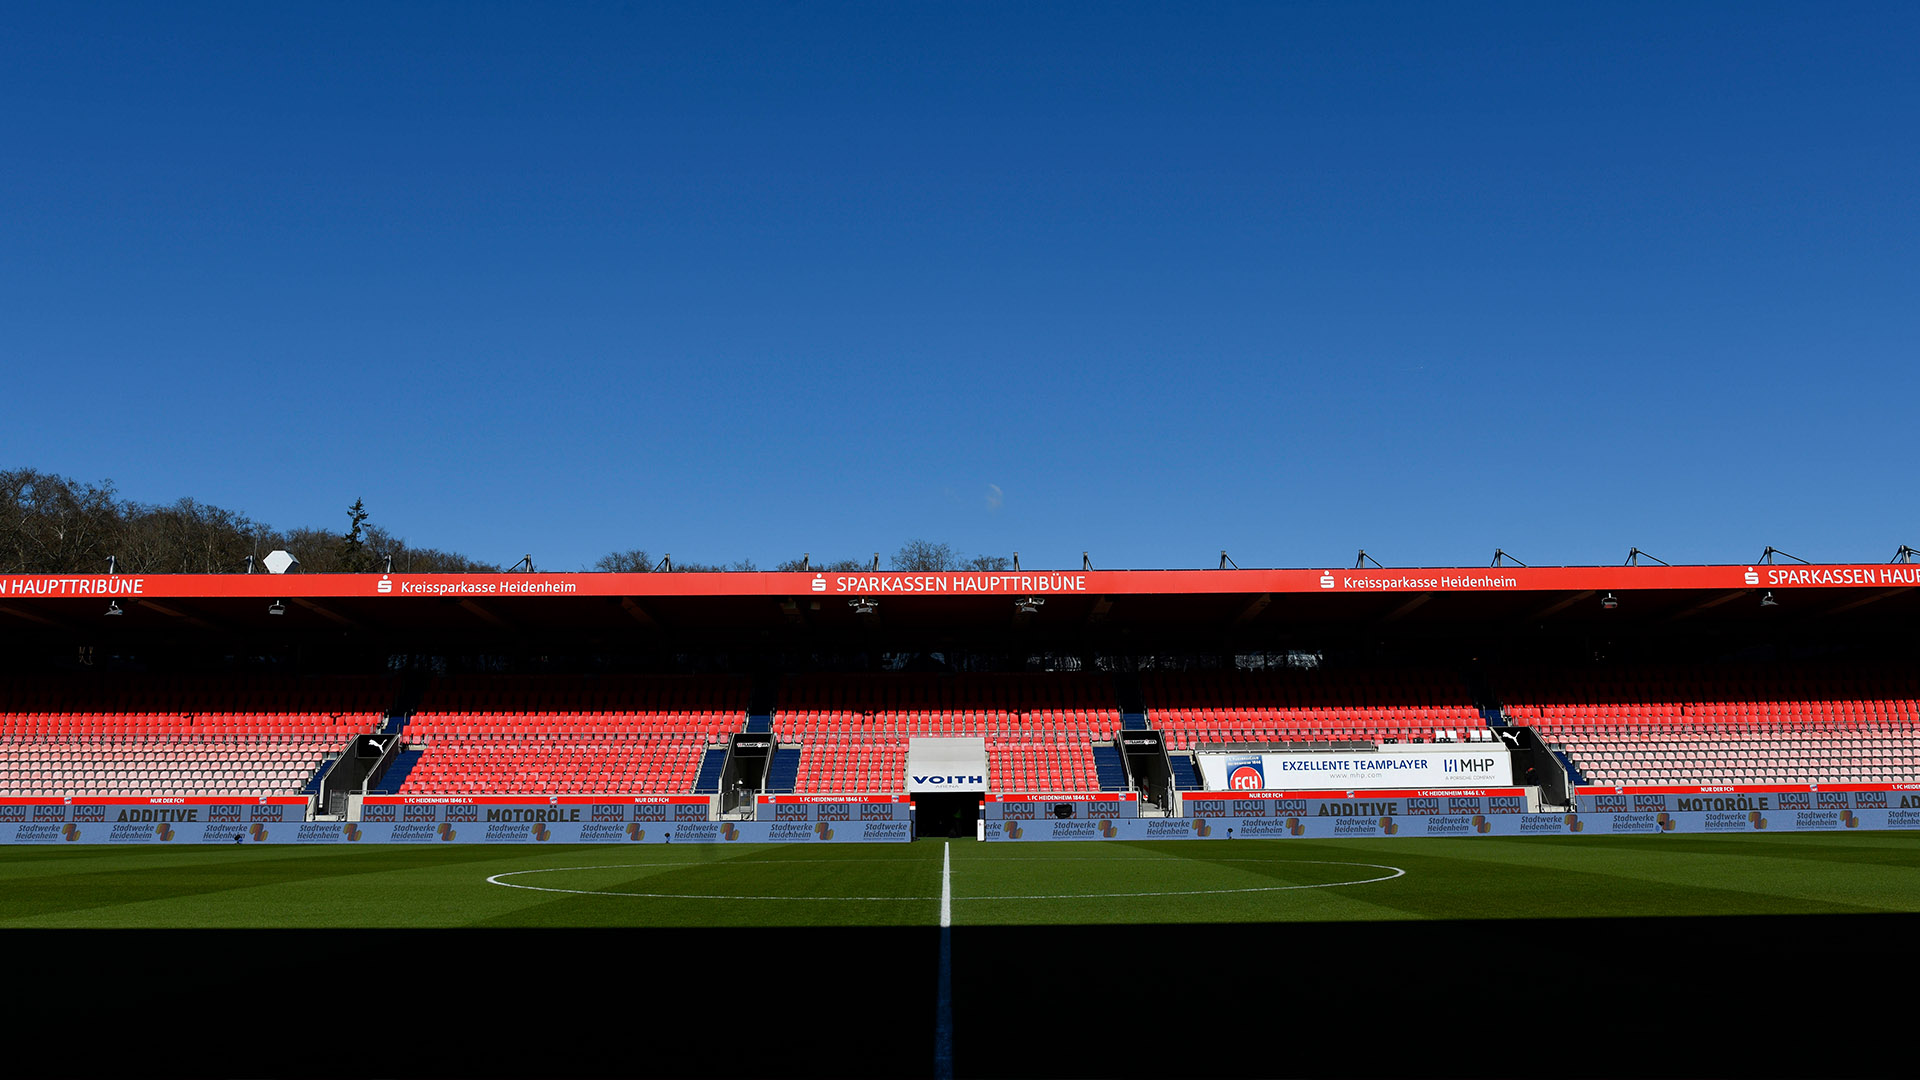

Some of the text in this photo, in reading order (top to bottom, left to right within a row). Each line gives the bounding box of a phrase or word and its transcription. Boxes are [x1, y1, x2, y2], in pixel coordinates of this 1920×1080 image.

[1768, 569, 1875, 584] SPARKASSEN
[12, 577, 144, 594] HAUPTTRIBÜNE
[837, 573, 1086, 592] SPARKASSEN HAUPTTRIBÜNE
[1344, 576, 1517, 591] Kreissparkasse Heidenheim
[402, 580, 576, 595] Kreissparkasse Heidenheim
[1283, 759, 1428, 771] EXZELLENTE TEAMPLAYER
[1460, 758, 1495, 772] MHP
[912, 776, 982, 784] VOITH
[1235, 776, 1258, 790] FCH
[1597, 796, 1625, 805] LIQUI
[1636, 796, 1664, 805] LIQUI
[1780, 794, 1807, 803] LIQUI
[1818, 793, 1846, 802] LIQUI
[1857, 793, 1885, 802] LIQUI
[1195, 802, 1224, 811] LIQUI
[1235, 801, 1263, 810] LIQUI
[1277, 801, 1305, 810] LIQUI
[1409, 799, 1437, 808] LIQUI
[1450, 798, 1479, 807] LIQUI
[1490, 798, 1518, 807] LIQUI
[1678, 794, 1768, 811] MOTORÖLE
[0, 806, 25, 815] IQUI
[35, 806, 63, 815] LIQUI
[75, 806, 103, 815] LIQUI
[211, 806, 239, 815] LIQUI
[252, 806, 281, 815] LIQUI
[365, 806, 394, 815] LIQUI
[406, 806, 434, 815] LIQUI
[447, 806, 476, 815] LIQUI
[594, 805, 622, 815] LIQUI
[636, 805, 664, 815] LIQUI
[676, 805, 705, 814] LIQUI
[777, 805, 806, 814] LIQUI
[819, 805, 848, 814] LIQUI
[862, 804, 891, 814] LIQUI
[1004, 803, 1033, 812] LIQUI
[1089, 803, 1118, 812] LIQUI
[1318, 802, 1397, 816] ADDITIVE
[117, 809, 198, 822] ADDITIVE
[487, 805, 580, 822] MOTORÖLE
[1613, 814, 1654, 822] Stadtwerke
[1705, 812, 1746, 820] Stadtwerke
[1797, 811, 1838, 819] Stadtwerke
[1242, 819, 1283, 827] Stadtwerke
[1336, 818, 1377, 826] Stadtwerke
[1521, 815, 1562, 823] Stadtwerke
[18, 824, 60, 832] Stadtwerke
[113, 824, 154, 832] Stadtwerke
[206, 824, 247, 832] Stadtwerke
[300, 824, 341, 832] Stadtwerke
[394, 824, 435, 832] Stadtwerke
[488, 824, 530, 832] Stadtwerke
[771, 823, 812, 831] Stadtwerke
[866, 822, 907, 830] Stadtwerke
[1054, 821, 1096, 829] Stadtwerke
[1148, 820, 1190, 828] Stadtwerke
[580, 831, 622, 839] Heidenheim
[674, 831, 716, 839] Heidenheim
